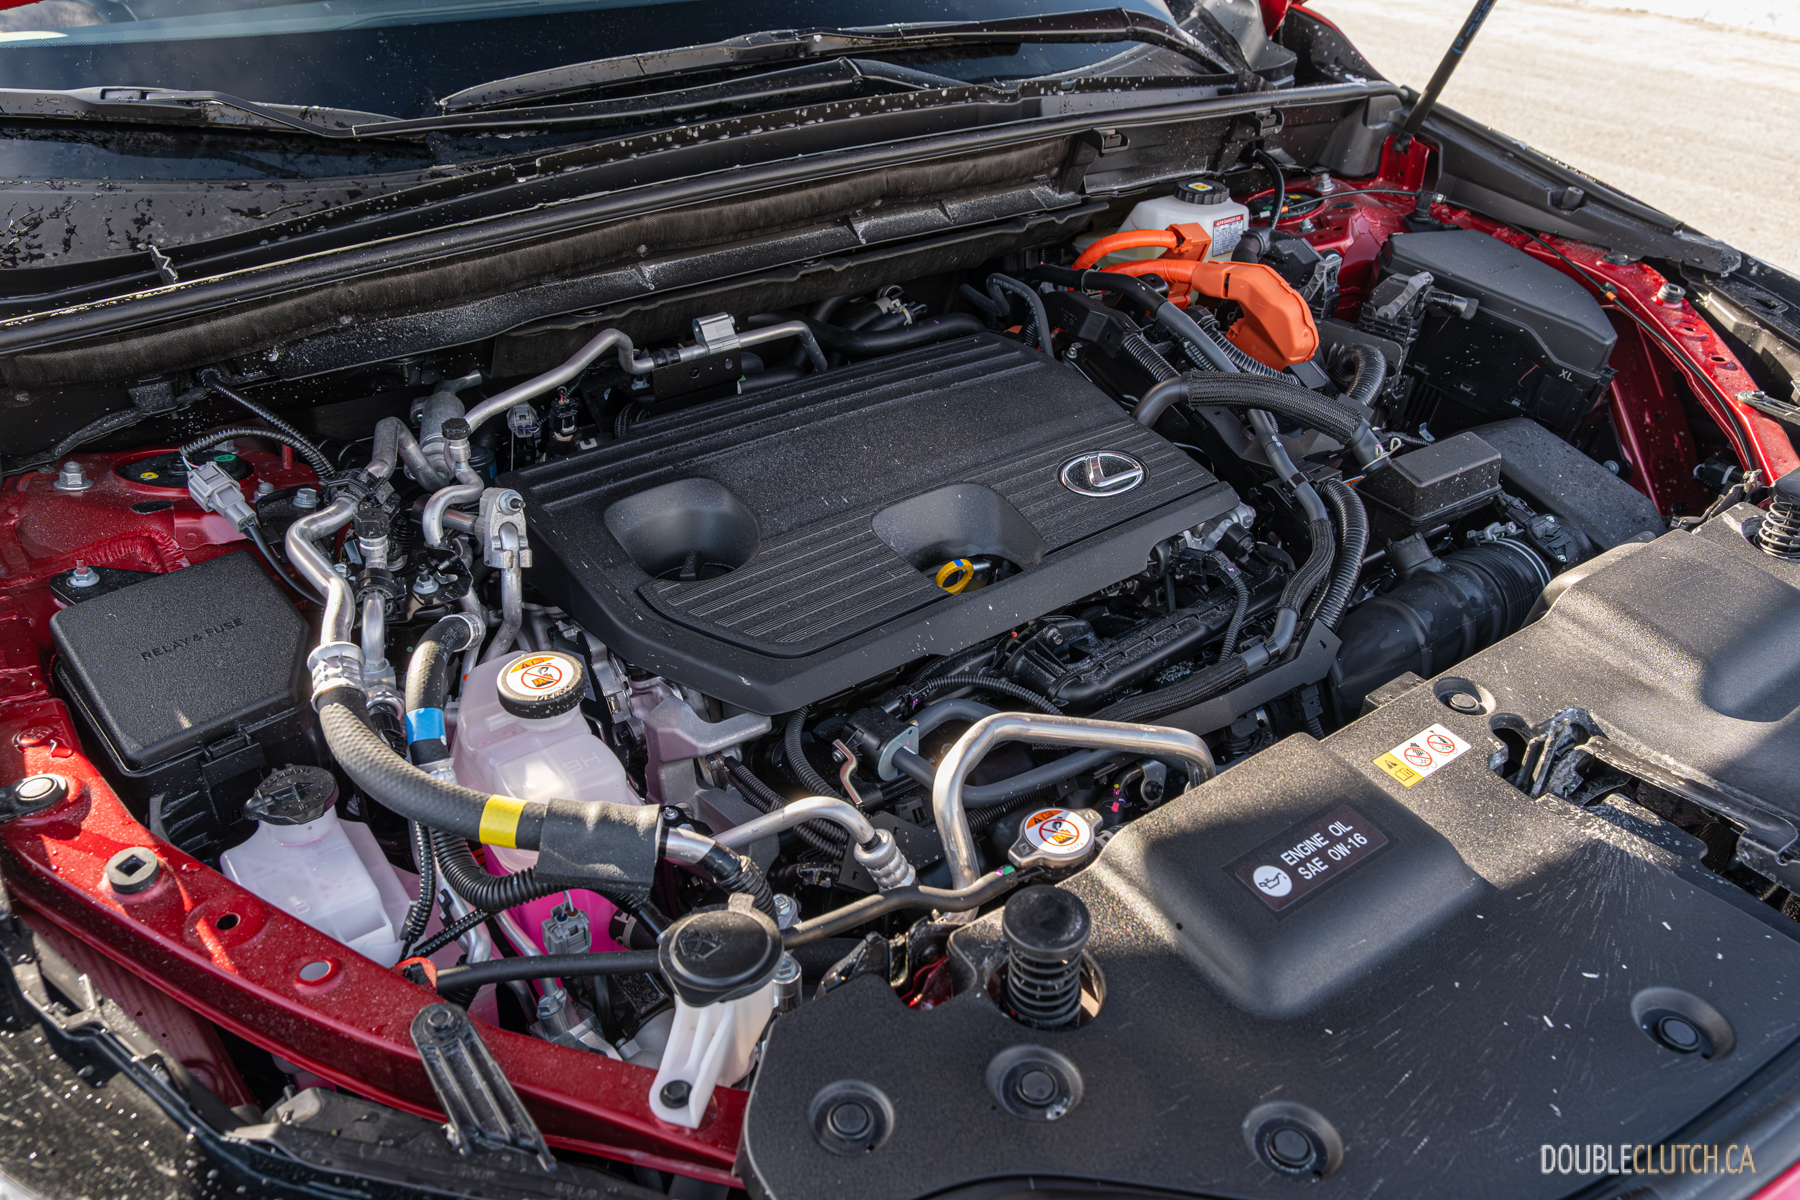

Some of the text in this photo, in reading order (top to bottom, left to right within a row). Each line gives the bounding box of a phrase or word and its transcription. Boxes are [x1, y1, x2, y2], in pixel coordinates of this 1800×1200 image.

[1558, 368, 1573, 382] XL
[140, 618, 244, 661] RELAY & FUSE
[1280, 819, 1353, 867] ENGINE OIL
[1297, 832, 1368, 880] SAE 0W-16
